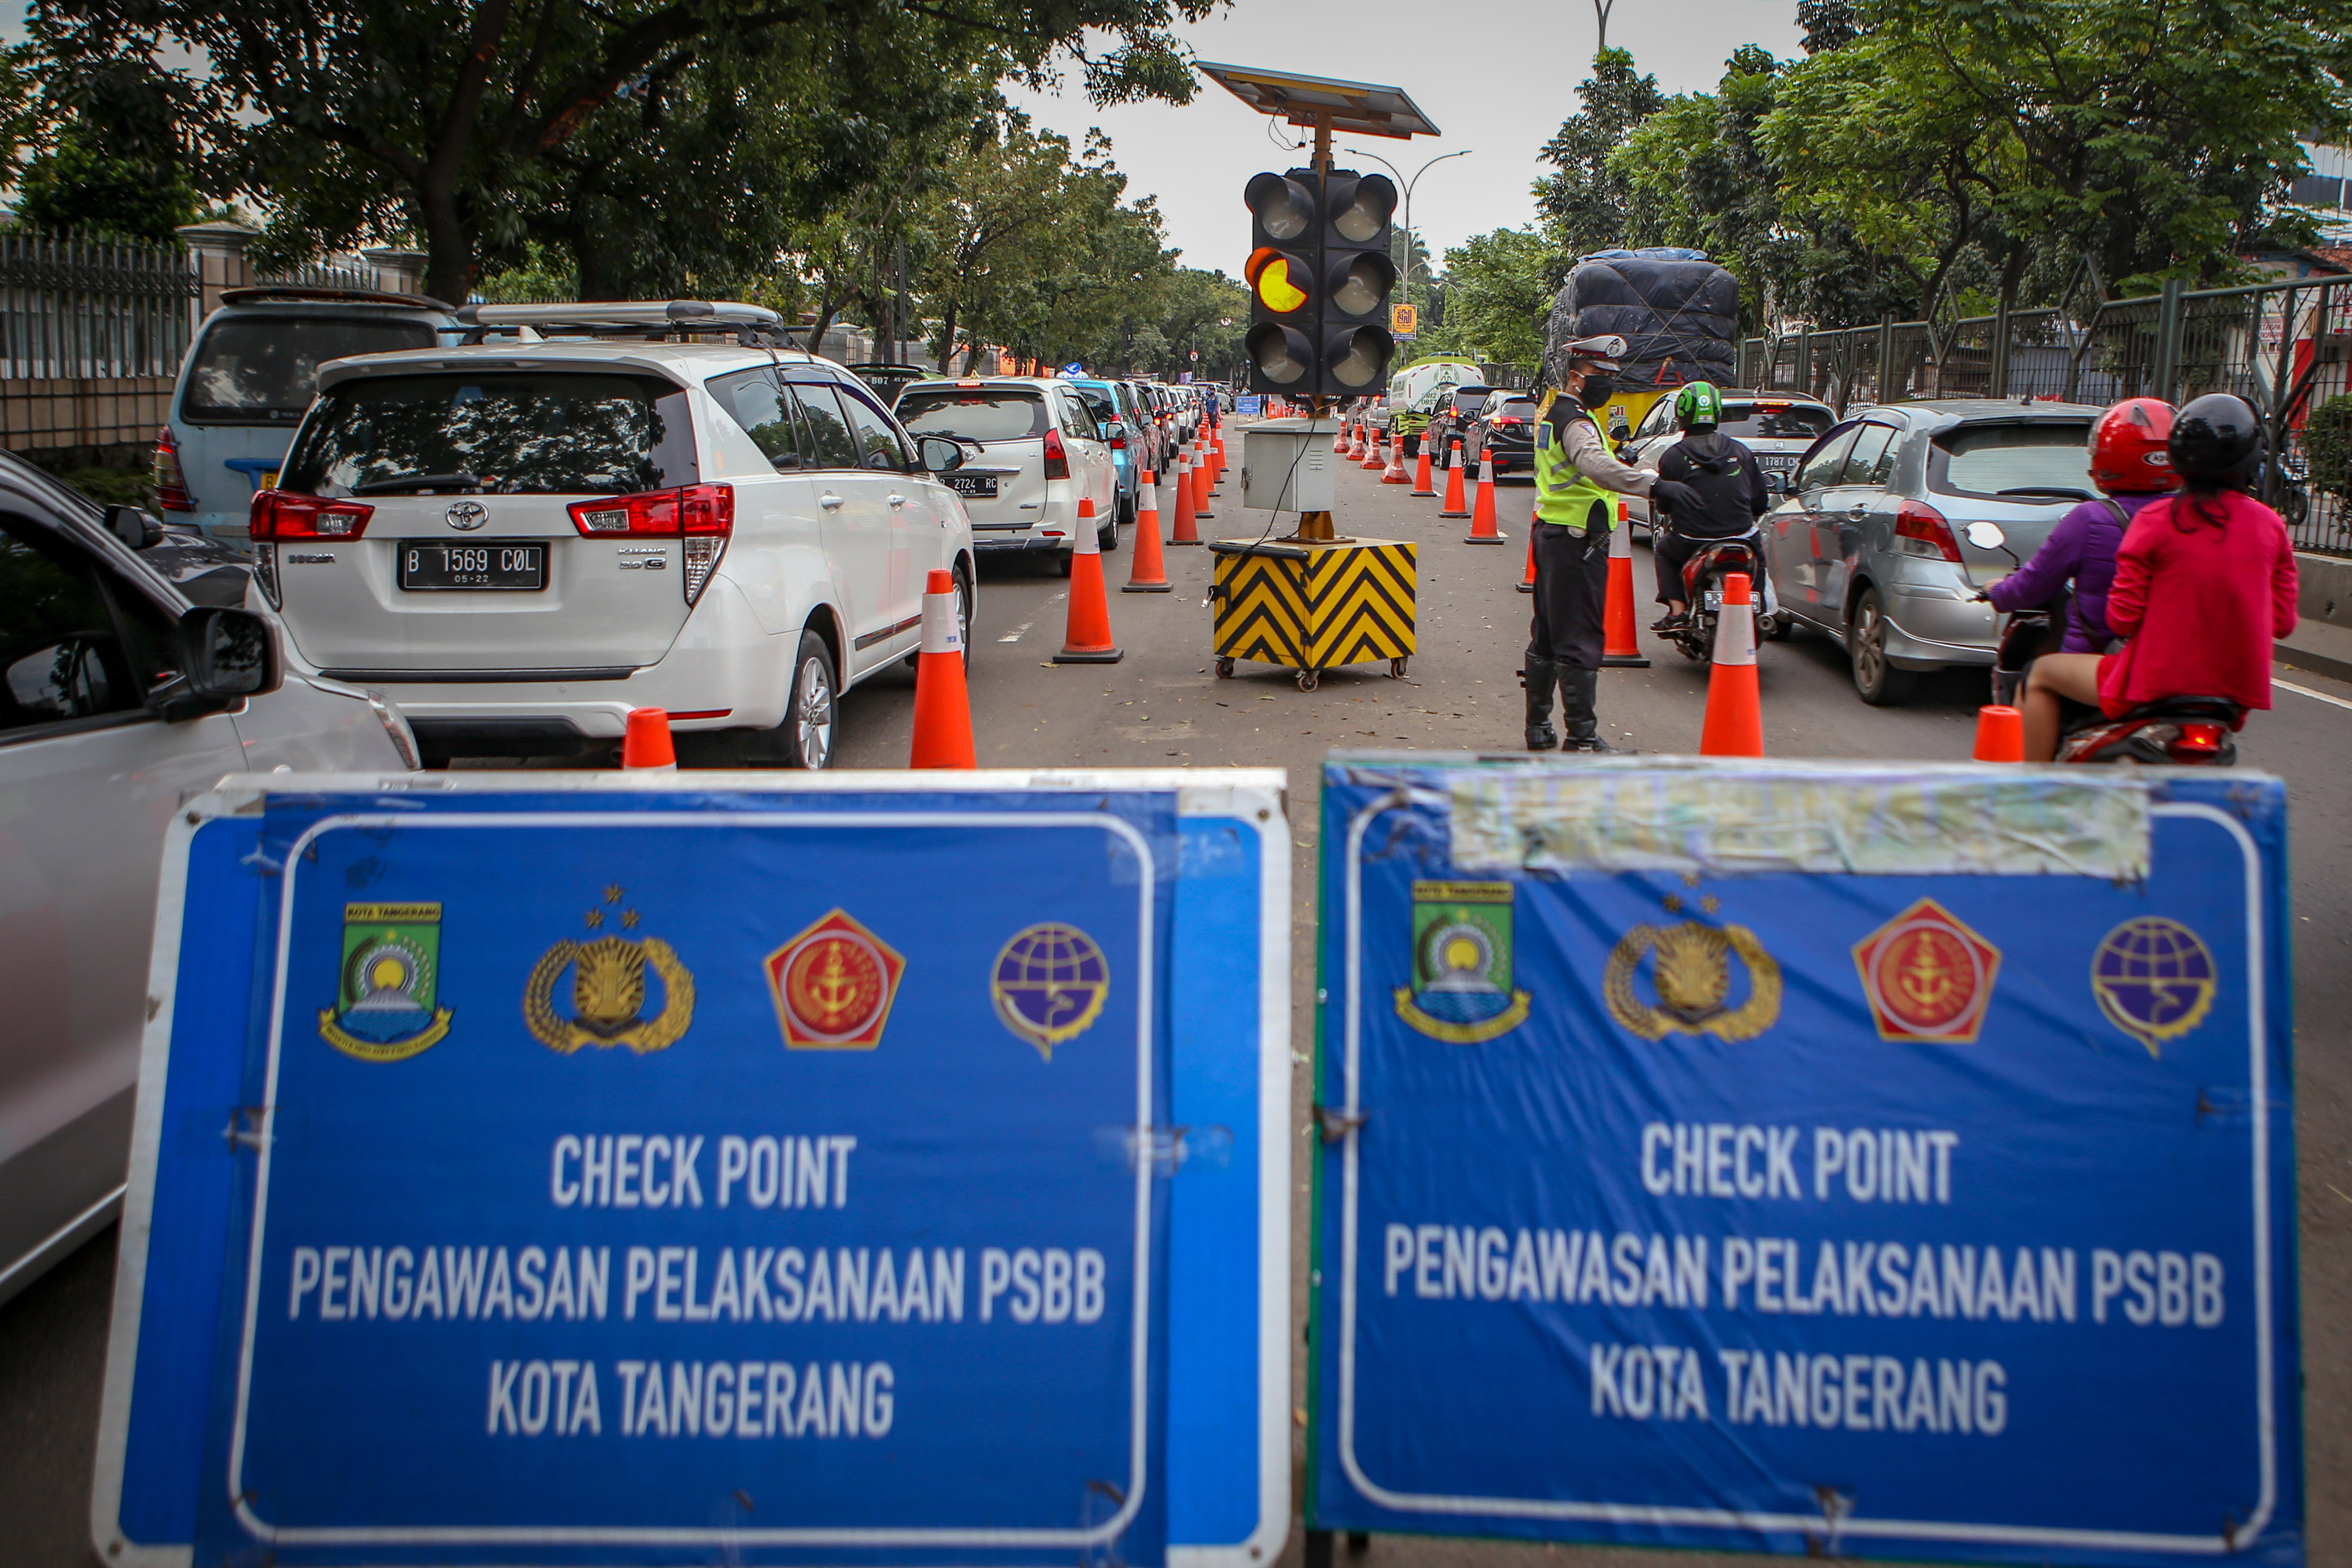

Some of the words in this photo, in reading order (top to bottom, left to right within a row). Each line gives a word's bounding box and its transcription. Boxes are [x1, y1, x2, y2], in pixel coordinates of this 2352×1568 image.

[954, 479, 976, 489] 2724
[986, 478, 997, 489] RC
[1765, 457, 1784, 466] 1787
[409, 550, 420, 572] B
[443, 549, 488, 572] 1569
[553, 1136, 703, 1206] CHECK
[719, 1136, 856, 1207] POINT
[1642, 1123, 1800, 1198] CHECK
[1815, 1128, 1958, 1202] POINT
[291, 1247, 609, 1318] PENGAWASAN
[626, 1247, 965, 1320] PELAKSANAAN
[981, 1249, 1105, 1322] PSBB
[1386, 1225, 1707, 1306] PENGAWASAN
[1723, 1238, 2073, 1320] PELAKSANAAN
[2094, 1251, 2223, 1326] PSBB
[489, 1362, 600, 1433] KOTA
[619, 1362, 894, 1435] TANGERANG
[1591, 1346, 1706, 1419] KOTA
[1720, 1351, 2006, 1433] TANGERANG
